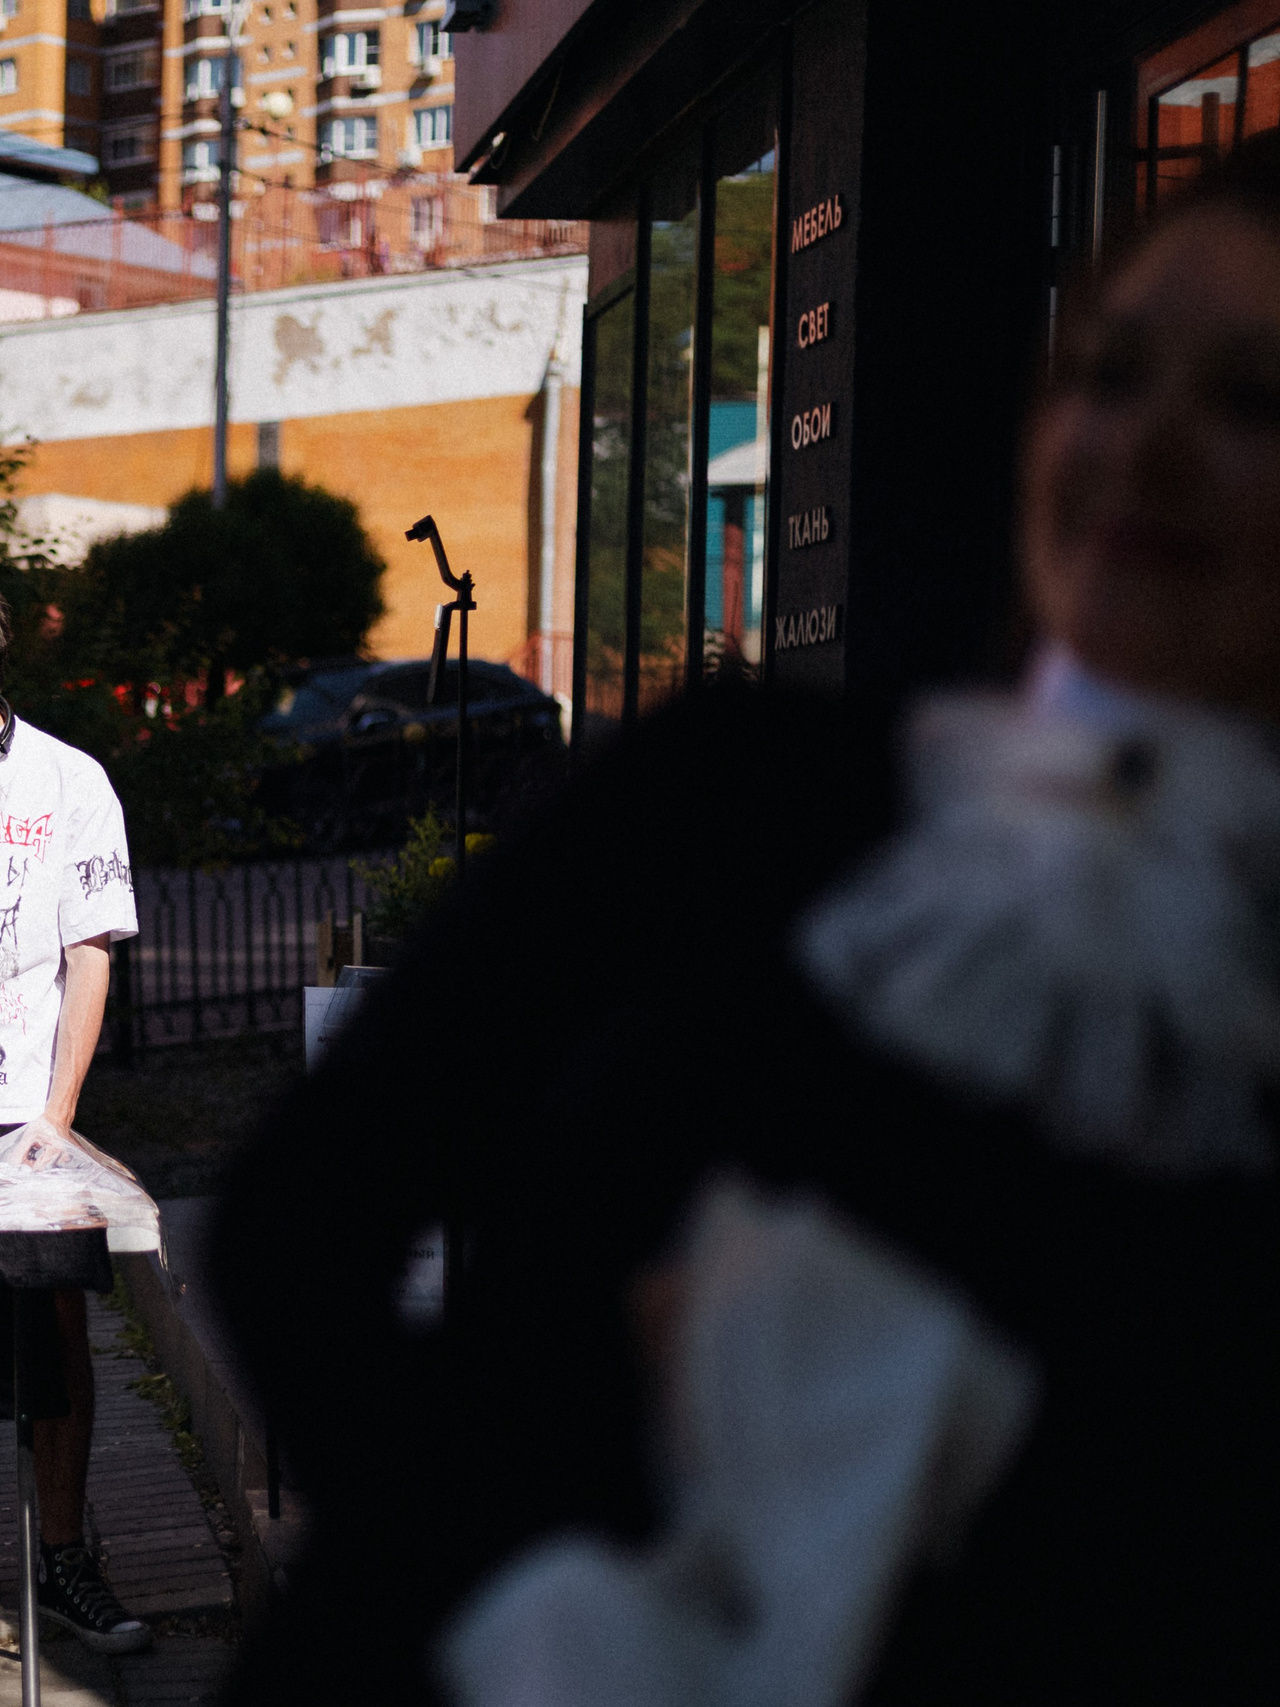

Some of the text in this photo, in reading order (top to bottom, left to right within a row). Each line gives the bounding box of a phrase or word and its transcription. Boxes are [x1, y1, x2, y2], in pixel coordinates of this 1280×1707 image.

[791, 194, 842, 254] МЕБЕЛЬ
[798, 302, 830, 349] СВЕТ
[791, 402, 832, 450] ОБОИ
[788, 506, 830, 549] ТКАНЬ
[774, 604, 837, 651] ЖАЛЮЗИ
